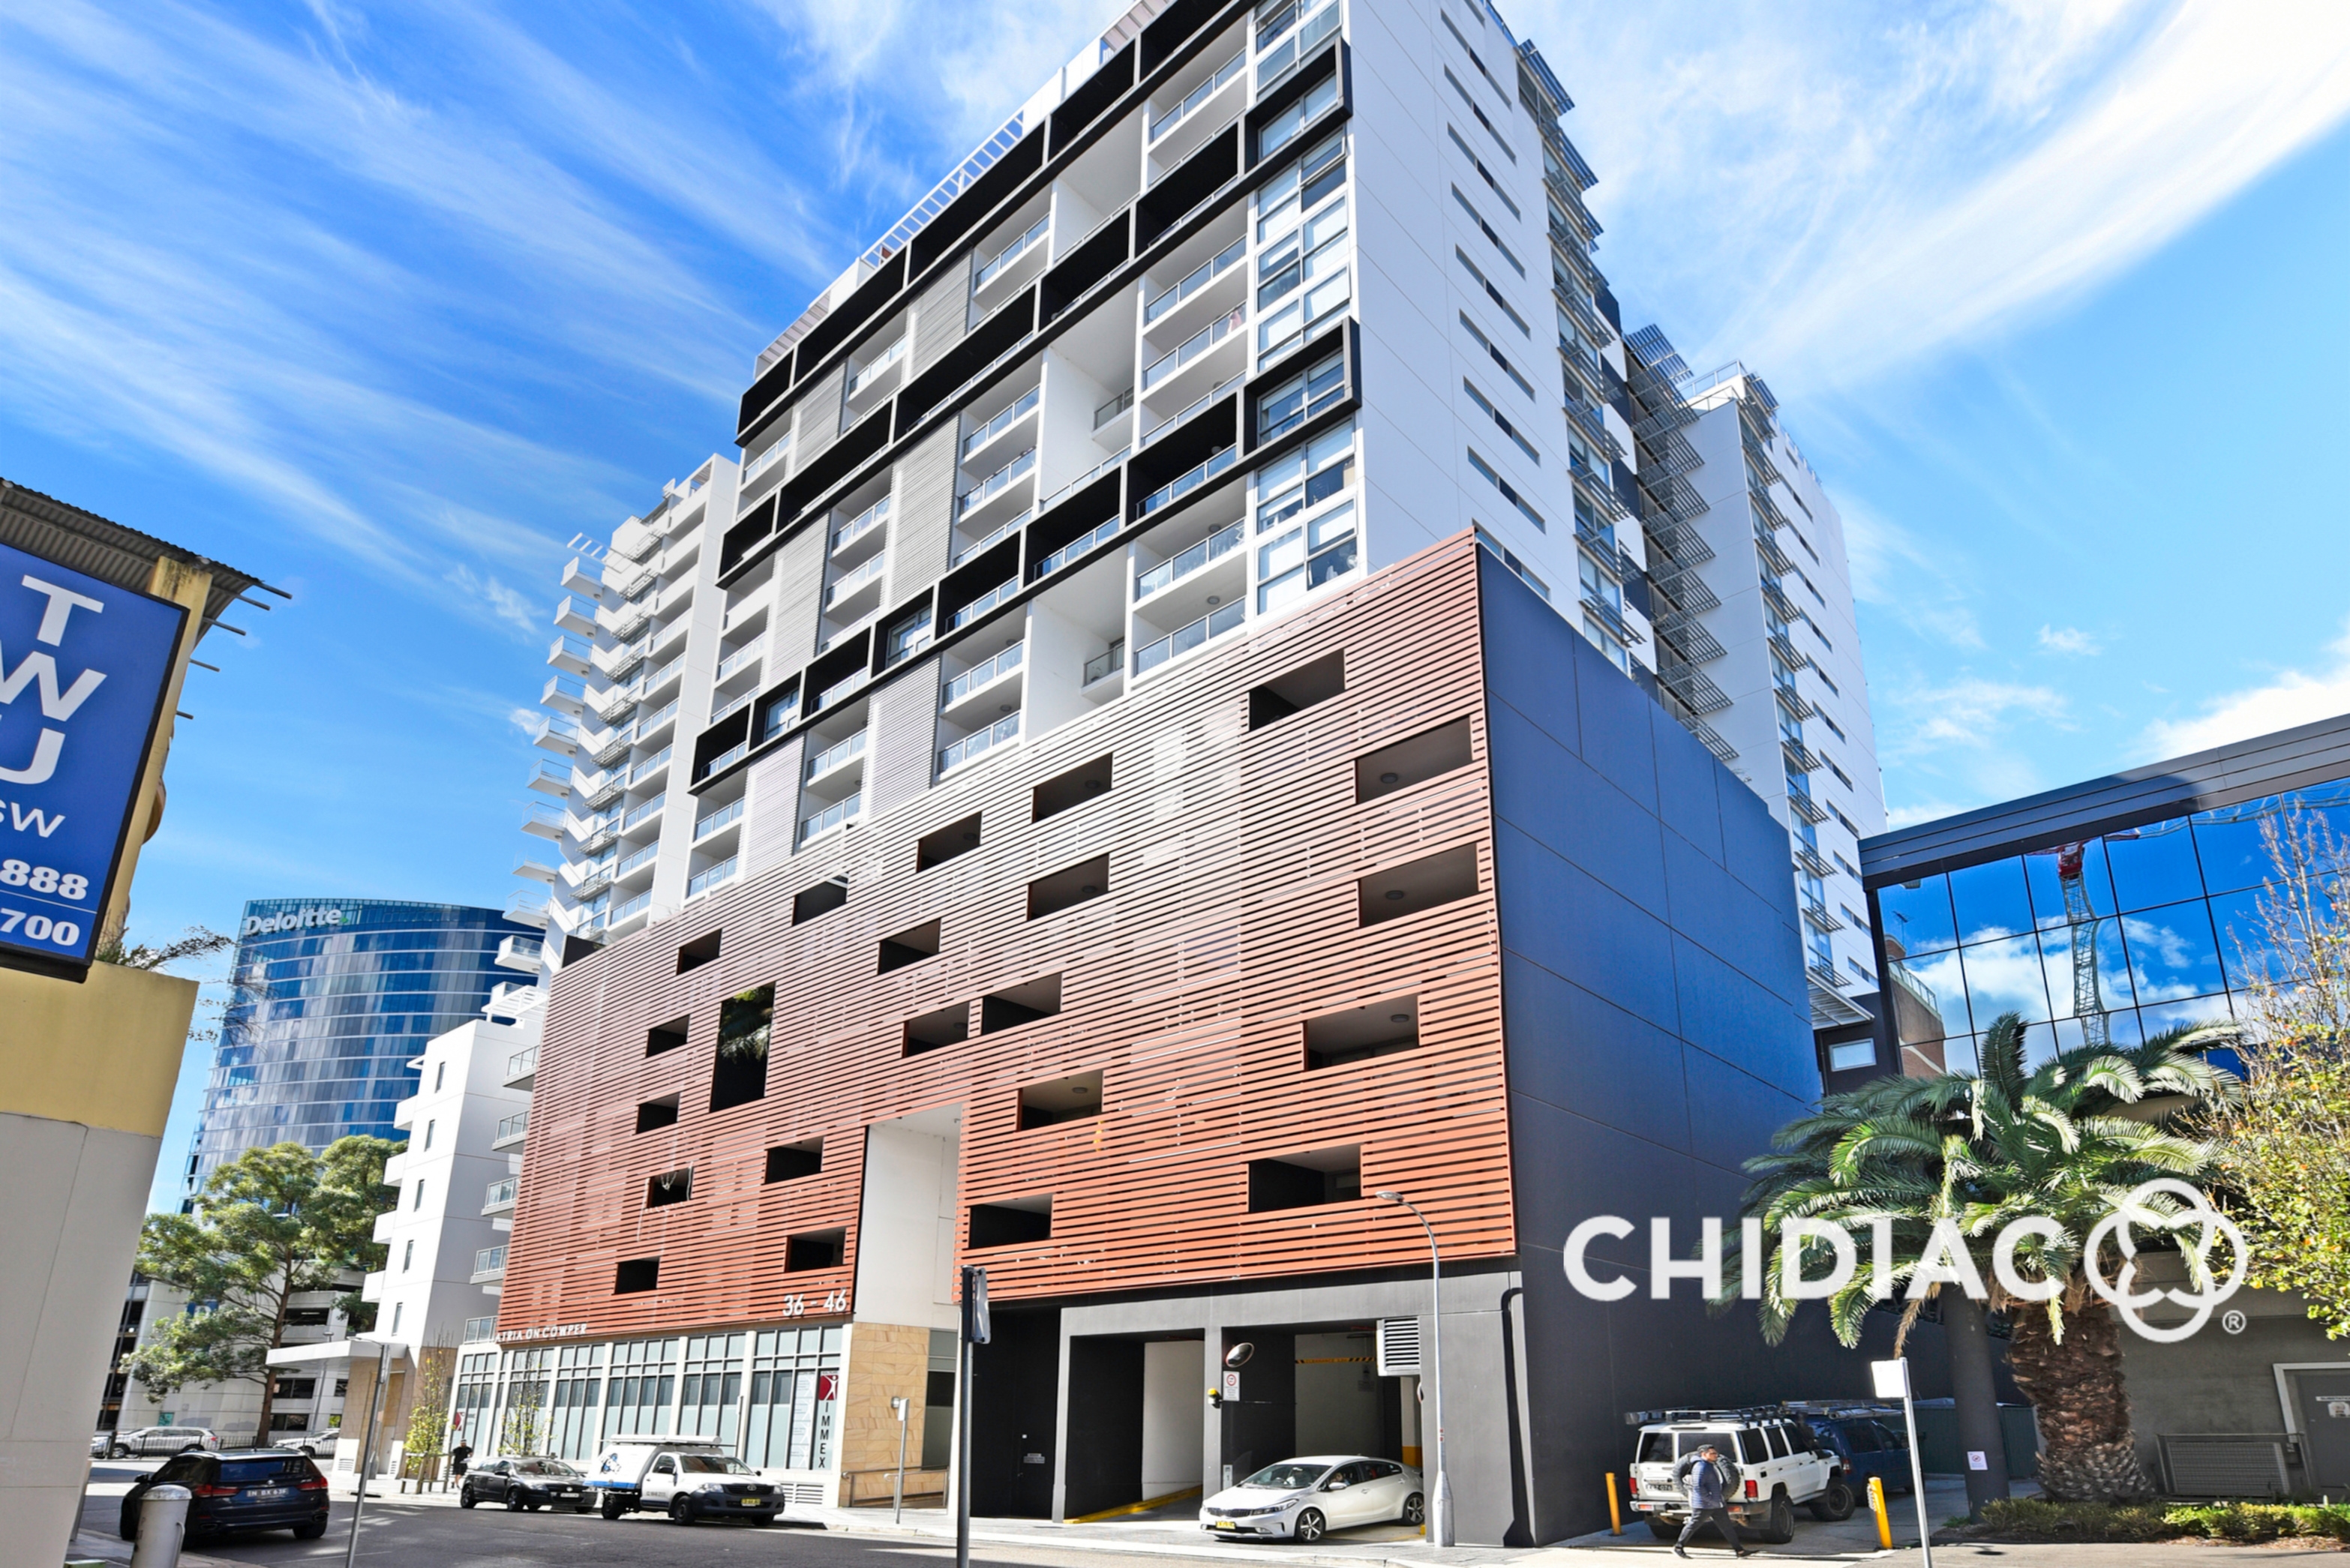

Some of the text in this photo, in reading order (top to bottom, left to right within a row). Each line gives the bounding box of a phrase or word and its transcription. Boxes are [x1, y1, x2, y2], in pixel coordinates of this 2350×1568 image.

[0, 859, 89, 901] 888
[0, 907, 80, 946] 700
[245, 907, 344, 937] Deloitte
[782, 1293, 805, 1317] 36
[823, 1288, 847, 1312] 46
[495, 1323, 587, 1342] ATRIA ON COWPER
[818, 1402, 830, 1468] IMMEX
